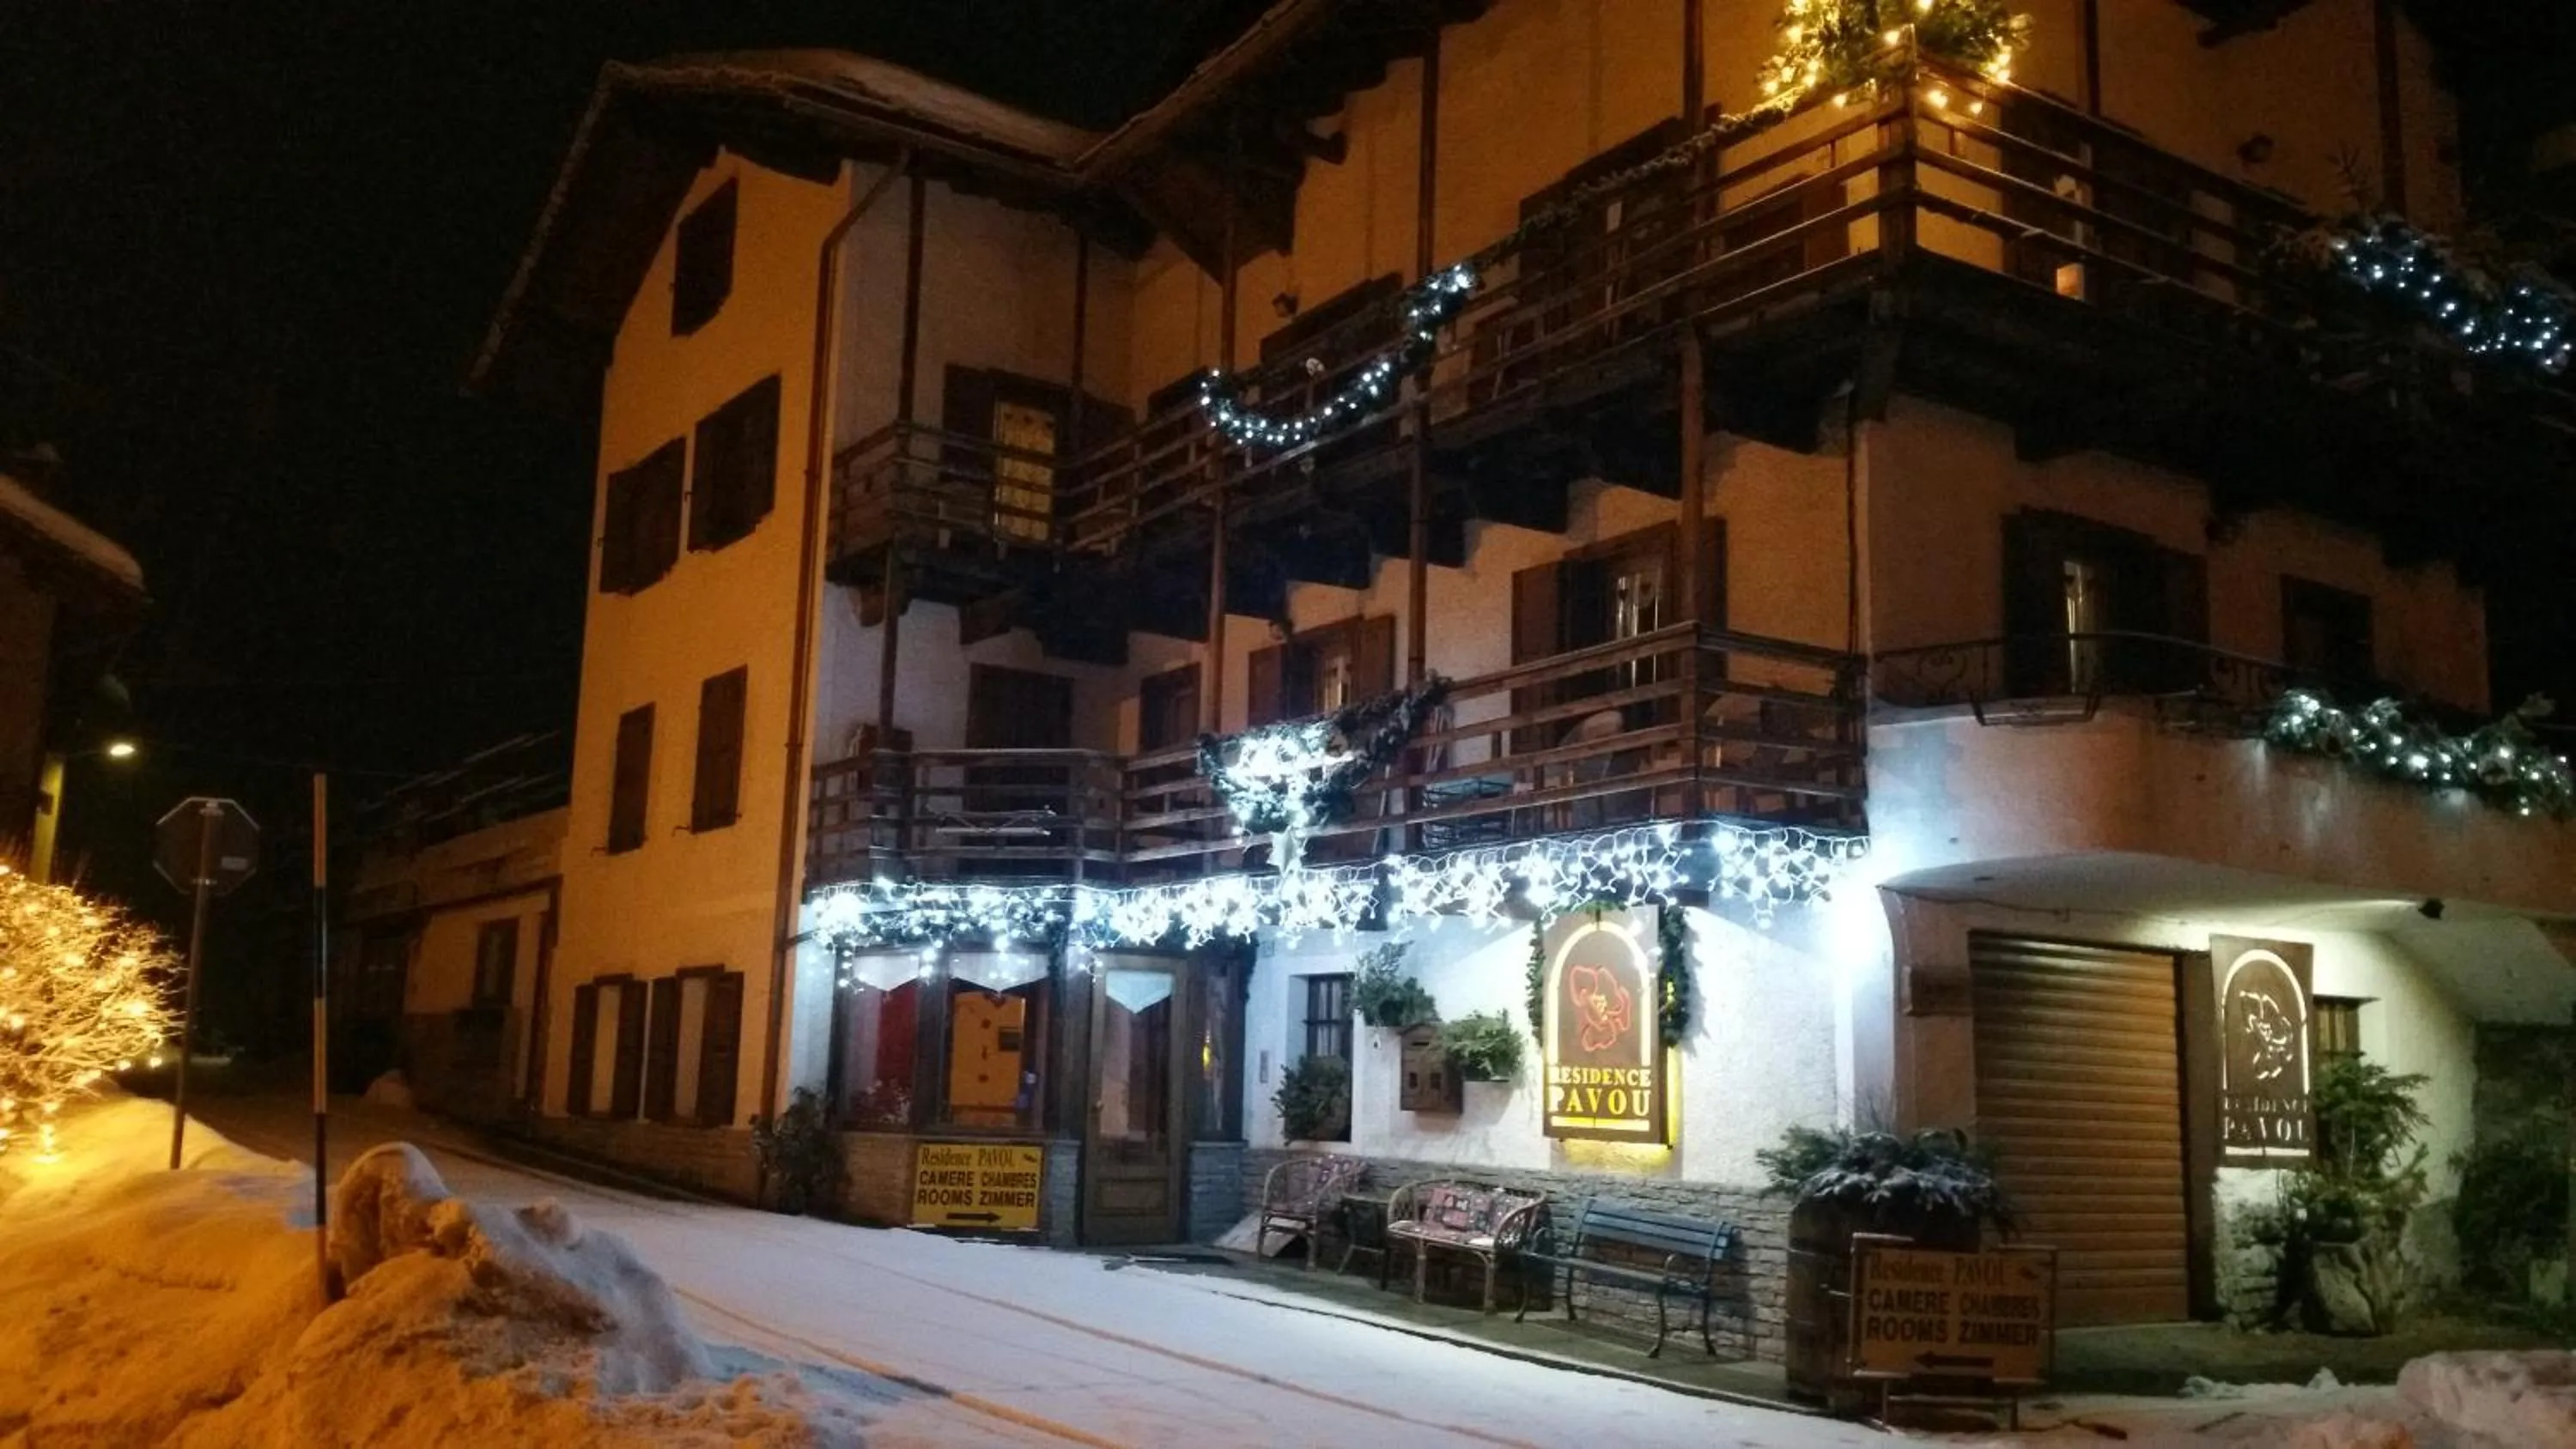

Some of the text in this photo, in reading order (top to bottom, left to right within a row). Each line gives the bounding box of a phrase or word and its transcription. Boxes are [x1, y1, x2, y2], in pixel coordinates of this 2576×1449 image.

[1547, 1066, 1652, 1087] RESIDENCE
[1547, 1085, 1651, 1117] PAVOU
[920, 1170, 1036, 1188] CAMERE CHAMBRES
[917, 1188, 1036, 1208] ROOMS ZIMMER
[1867, 1288, 2041, 1319] CAMERE CHAMBRES
[1866, 1316, 2039, 1347] ROOMS ZIMMER
